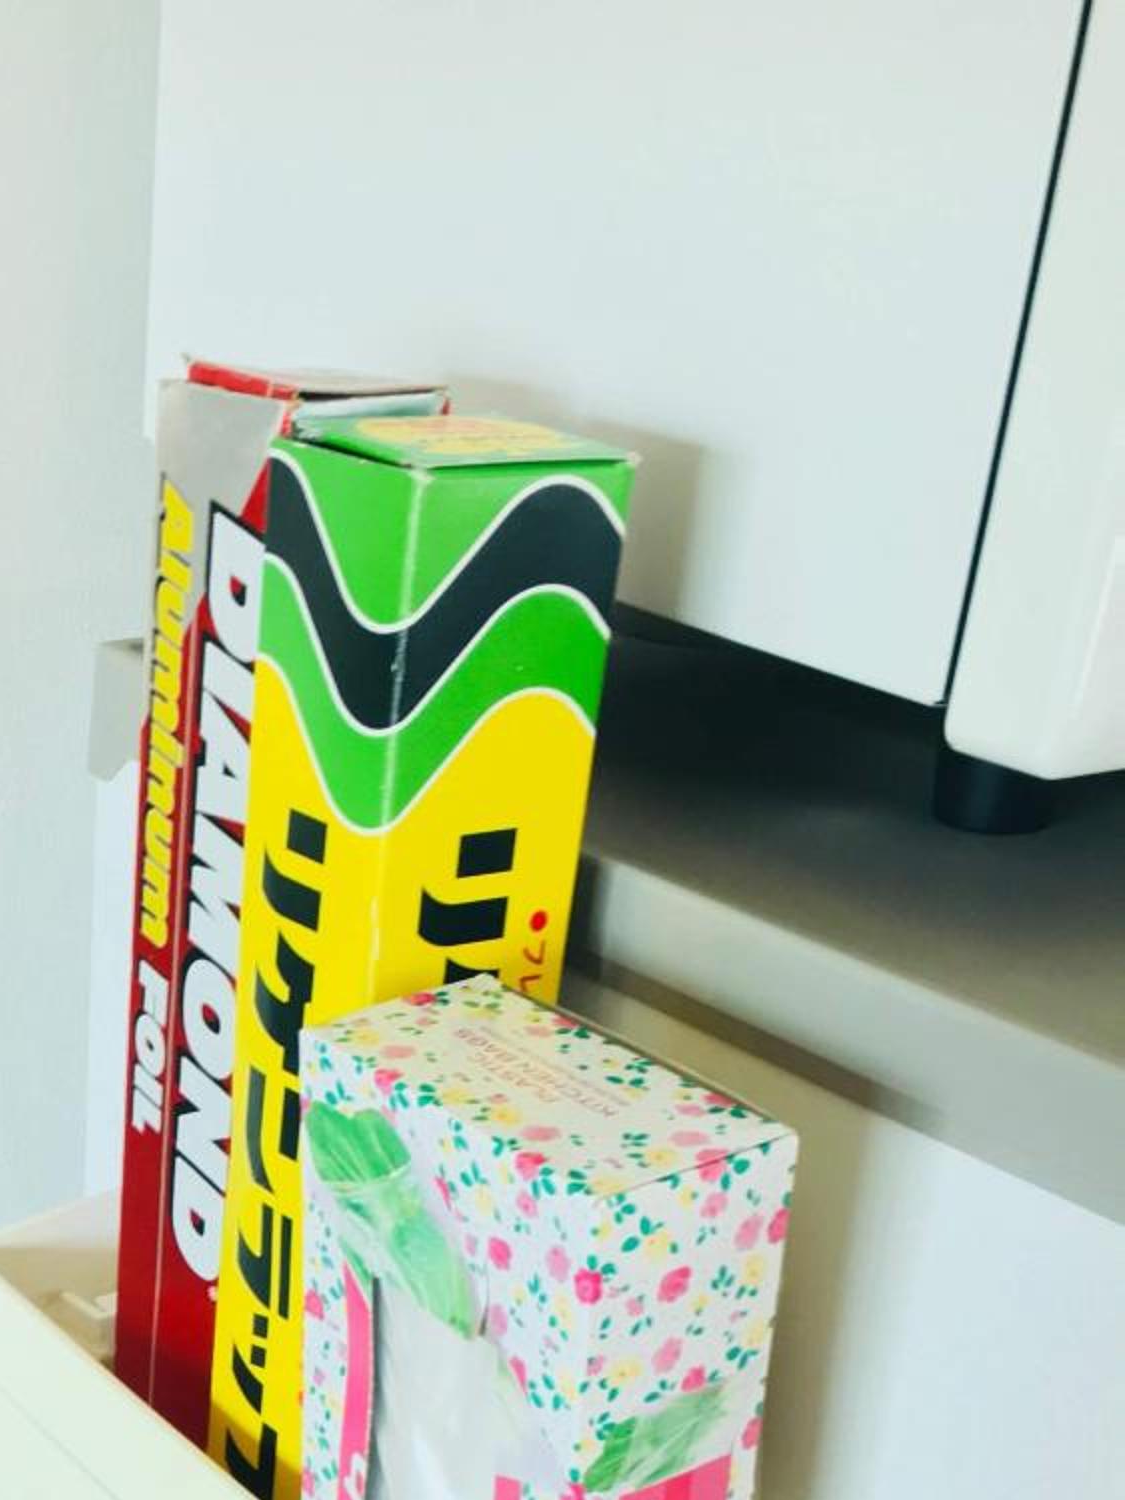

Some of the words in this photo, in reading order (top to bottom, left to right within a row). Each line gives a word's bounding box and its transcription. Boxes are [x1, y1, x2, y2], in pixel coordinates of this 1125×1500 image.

[139, 475, 195, 949] Aluminum
[171, 500, 266, 1283] DIAMOND
[130, 958, 170, 1136] FOIL
